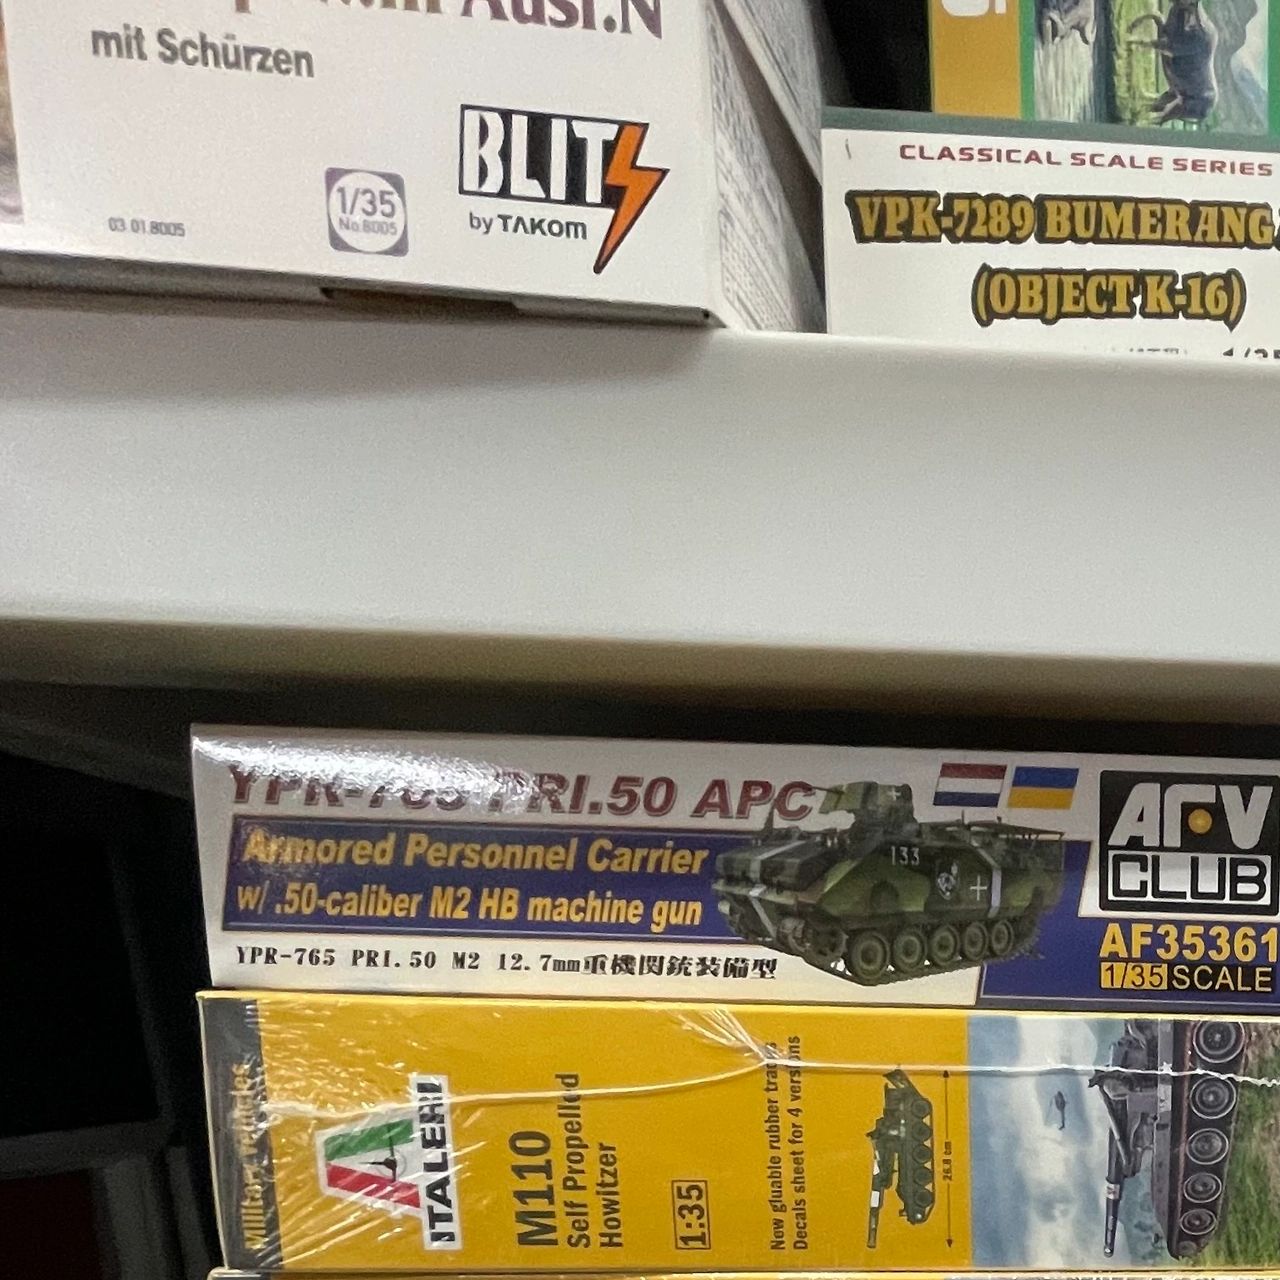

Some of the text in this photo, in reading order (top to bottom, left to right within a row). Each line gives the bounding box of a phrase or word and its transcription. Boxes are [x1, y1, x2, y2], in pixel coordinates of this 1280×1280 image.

[91, 24, 315, 78] mit Schürzen
[899, 144, 1274, 177] CLASSICAL SCALE SERIES
[336, 186, 396, 219] 1/35
[469, 212, 493, 235] by
[848, 191, 1035, 243] VPK-7289
[1038, 197, 1274, 249] BUMERANG
[973, 264, 1247, 331] (OBJECT K-16)
[690, 777, 815, 821] APC
[243, 828, 709, 875] Armored Personnel Carrier
[1111, 853, 1269, 902] CLUB
[236, 882, 703, 934] w/ .50-caliber M2 HB machine gun
[235, 945, 481, 971] YPR-765 M2
[1100, 920, 1279, 963] AF35361
[1103, 963, 1273, 992] 1/35 SCALE
[764, 1098, 782, 1151] rubber
[416, 1081, 455, 1243] ITALERI
[767, 1156, 788, 1214] gluable
[787, 1107, 809, 1251] Decals sheet for 4
[508, 1131, 559, 1247] M110
[596, 1142, 624, 1248] Howitzer
[676, 1183, 707, 1247] 1:35
[563, 1200, 591, 1249] Self
